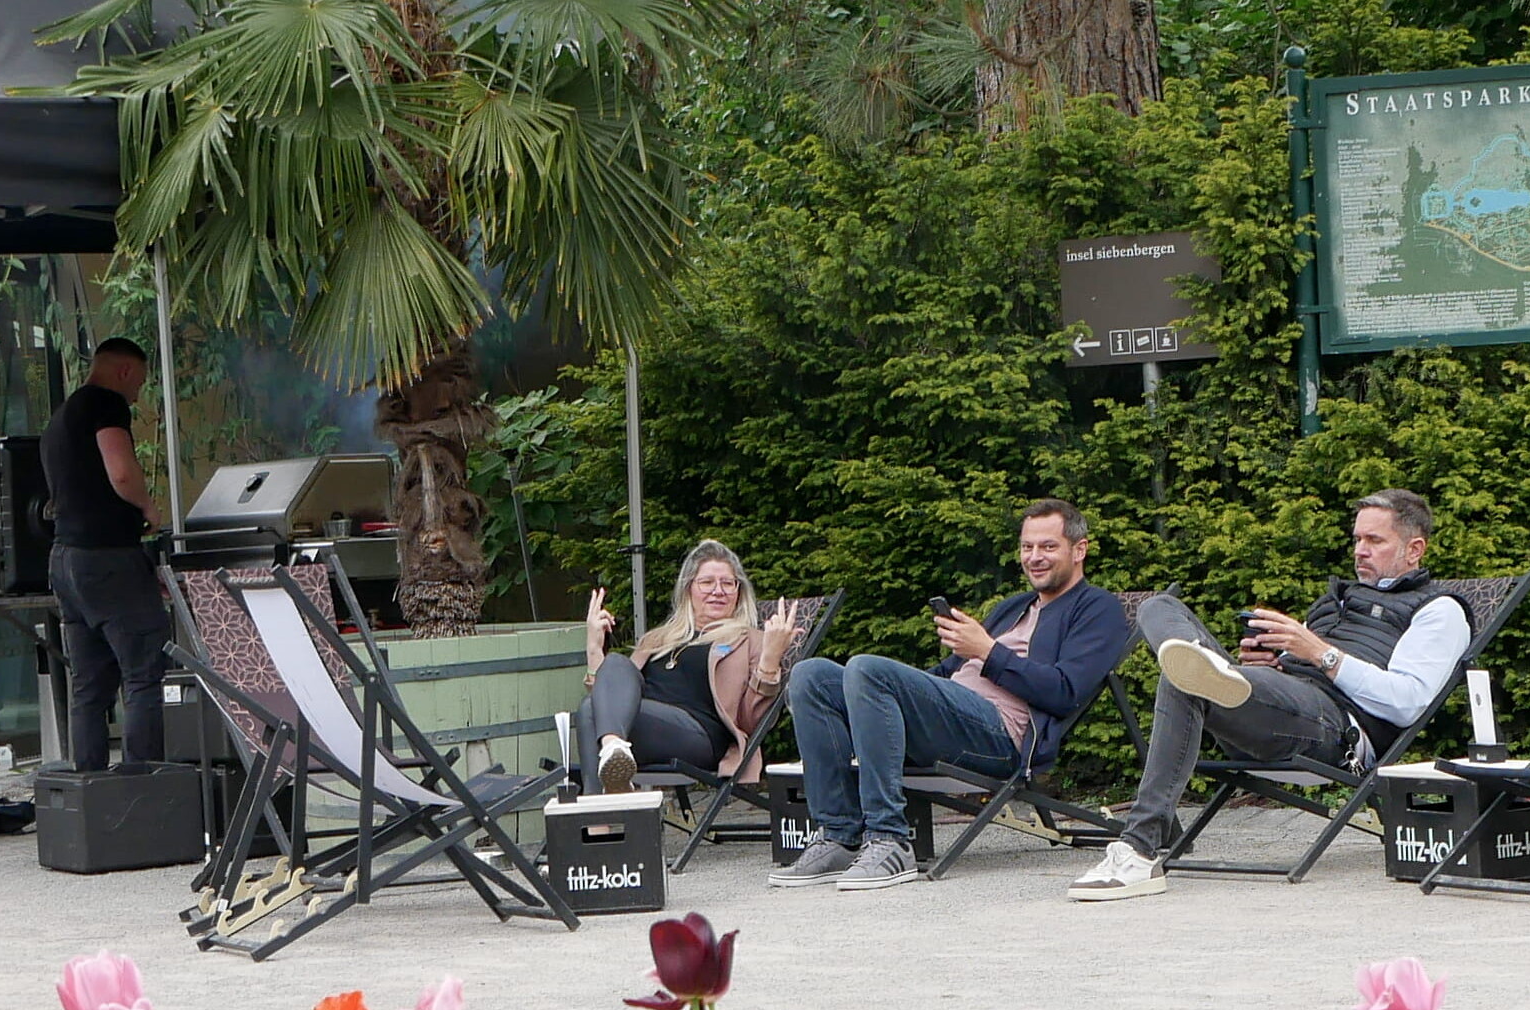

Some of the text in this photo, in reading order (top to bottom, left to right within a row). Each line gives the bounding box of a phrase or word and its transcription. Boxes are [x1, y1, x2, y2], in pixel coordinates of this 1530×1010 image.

[1066, 243, 1175, 262] insel siebenbergen
[1395, 824, 1468, 866] fritz-kol
[567, 863, 641, 891] fritz-kola
